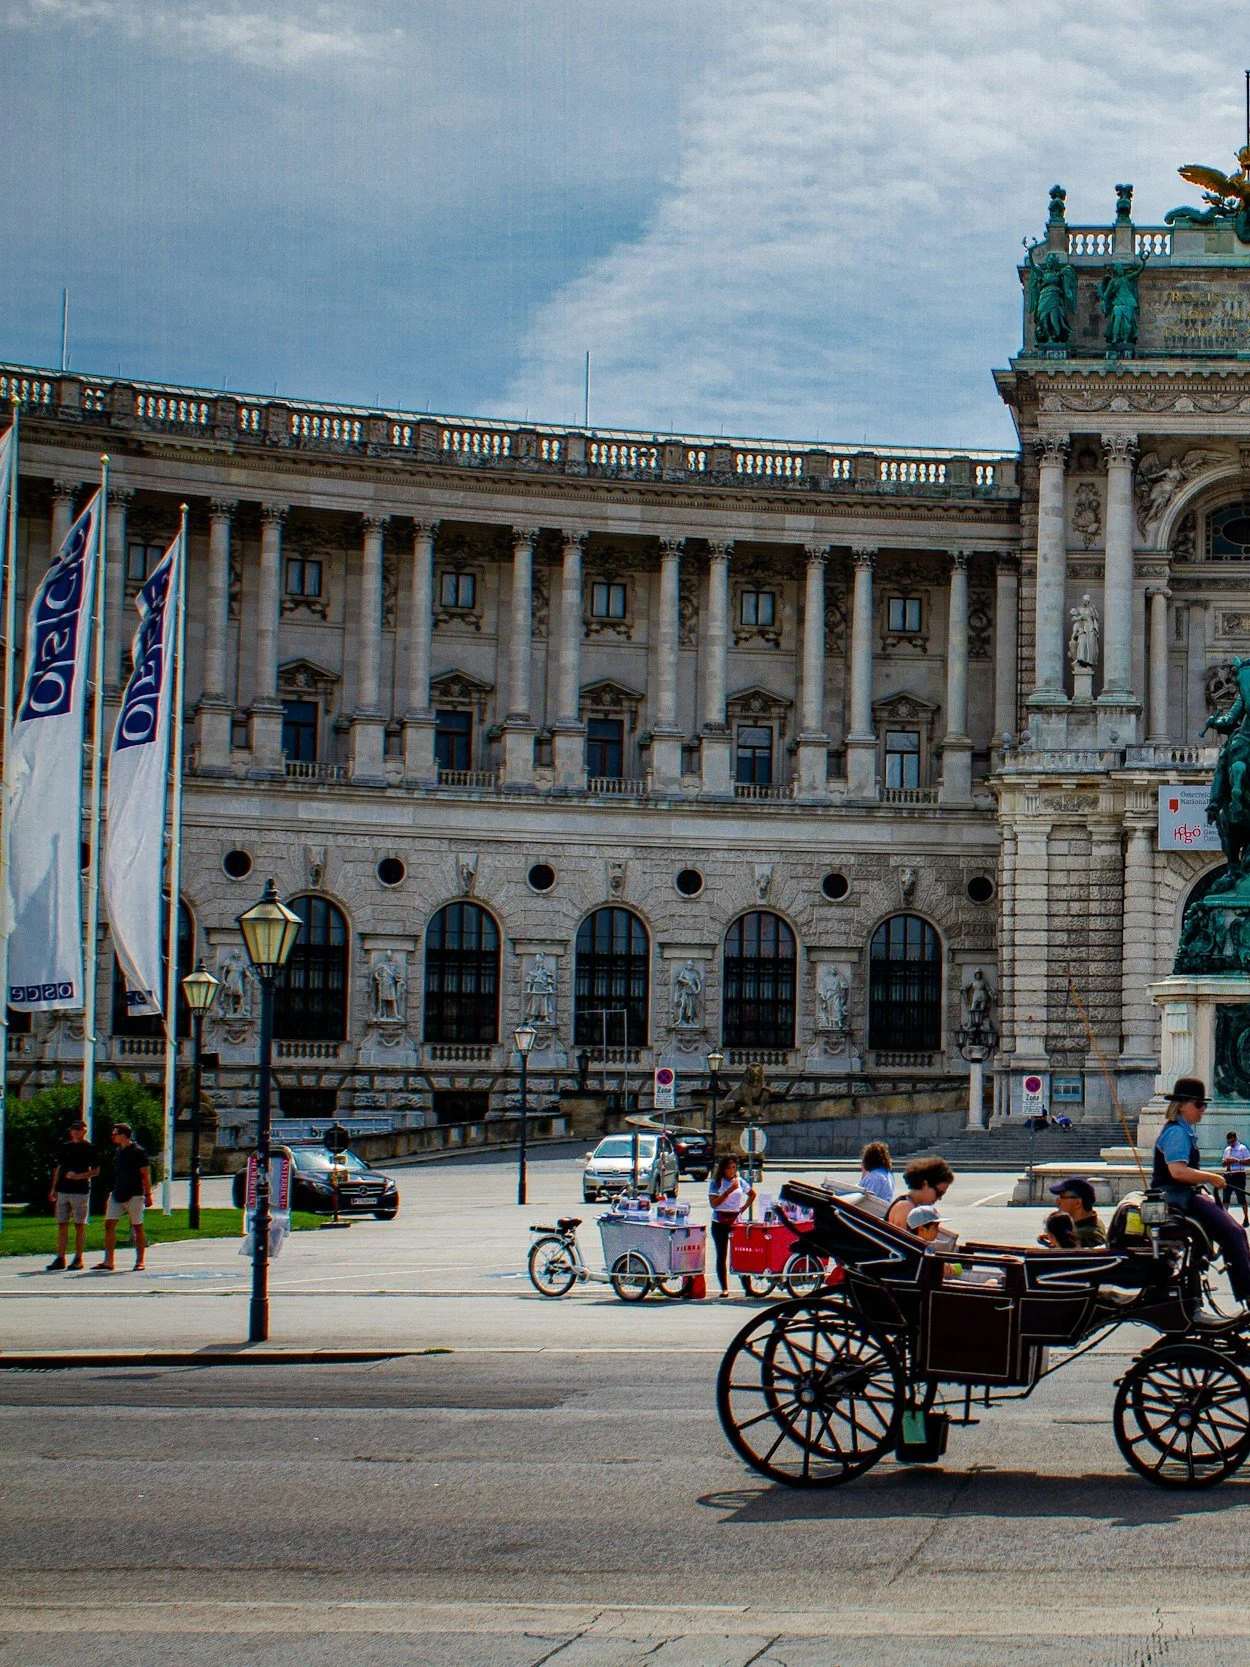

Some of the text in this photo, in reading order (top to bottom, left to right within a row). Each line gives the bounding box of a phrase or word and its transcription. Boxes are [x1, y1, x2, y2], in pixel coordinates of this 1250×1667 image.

[1180, 790, 1211, 798] Österreic
[657, 1086, 672, 1094] Zone
[676, 1244, 701, 1252] VIENNA
